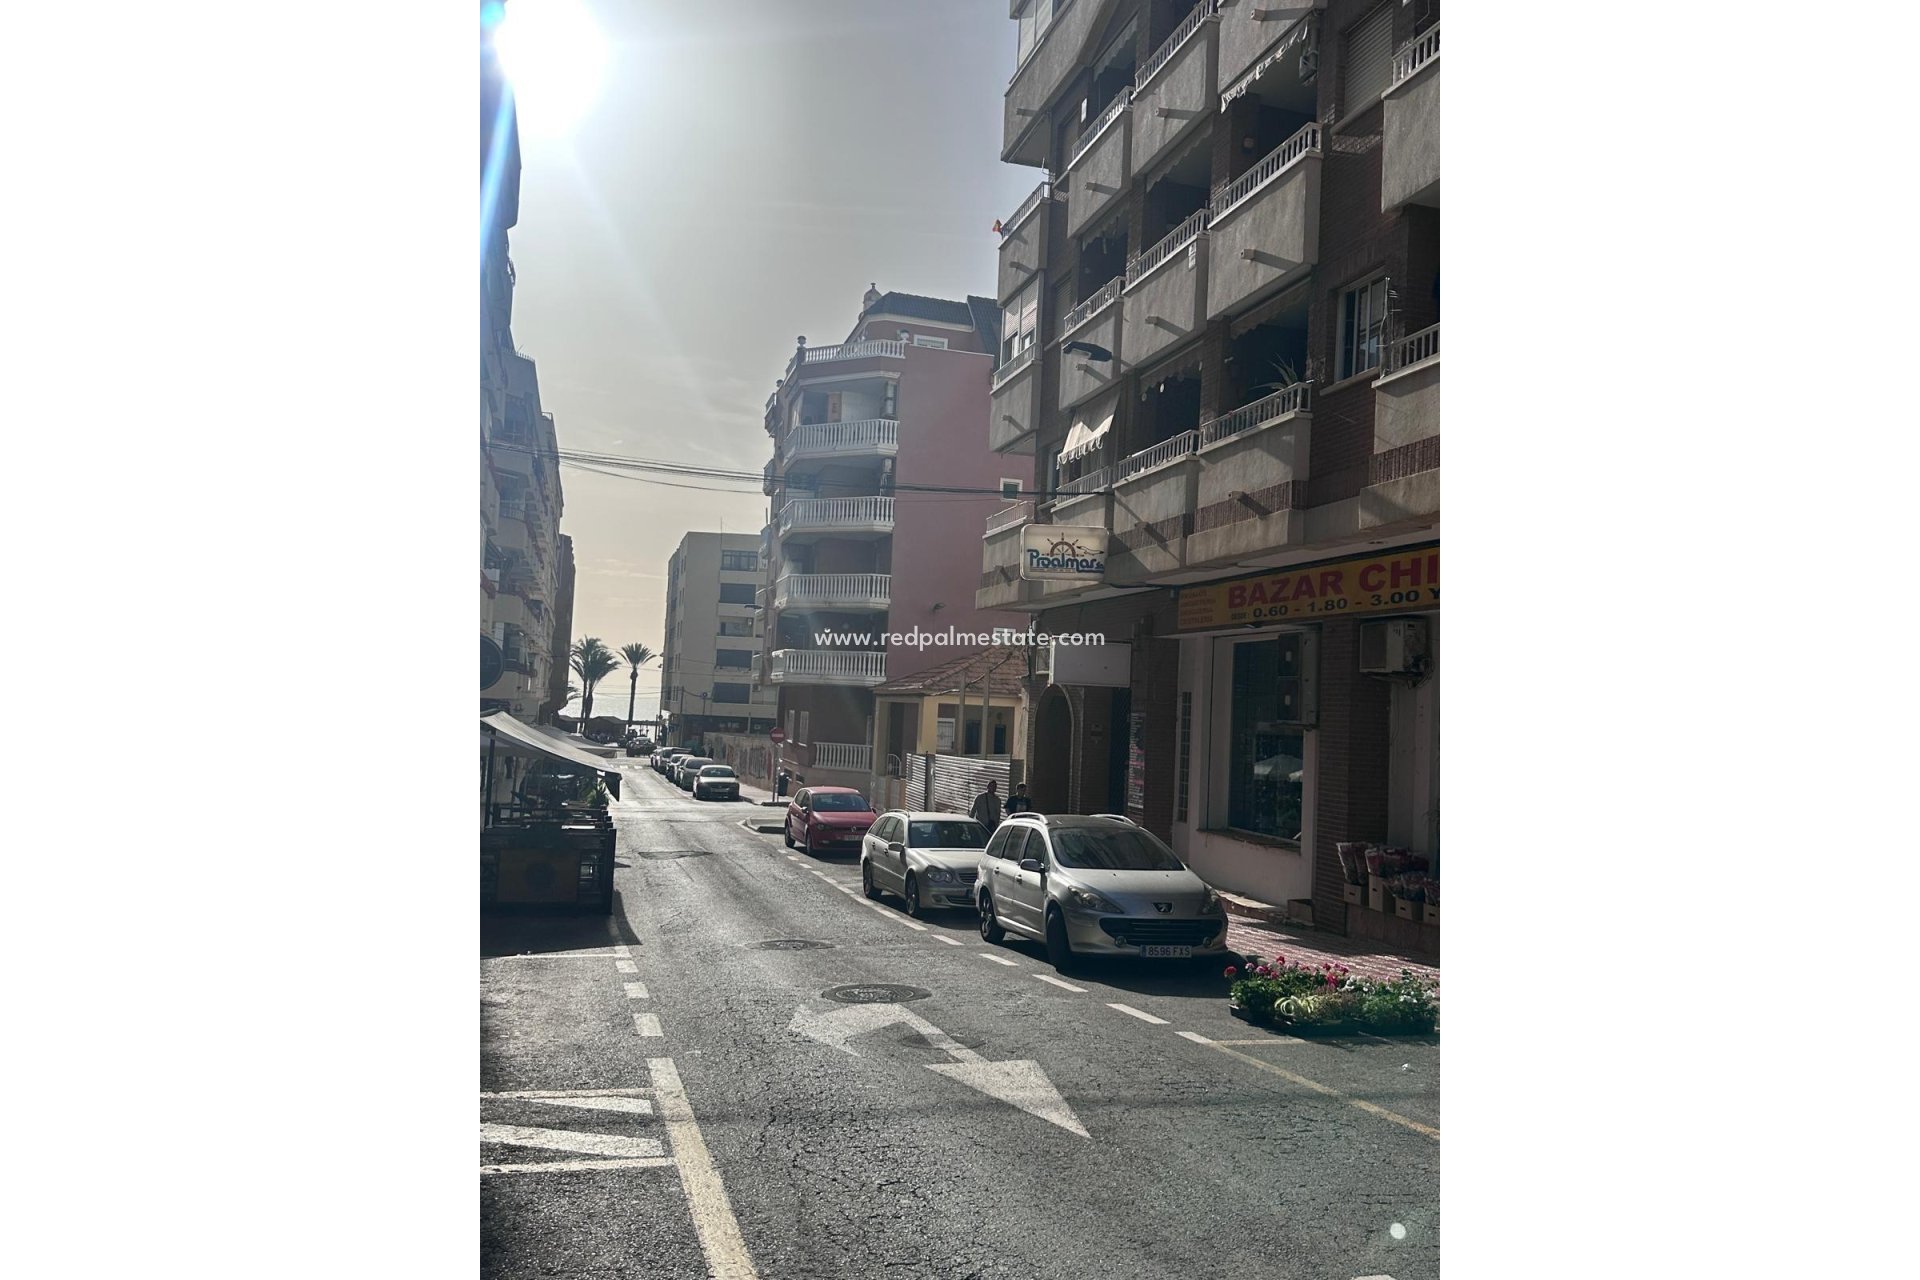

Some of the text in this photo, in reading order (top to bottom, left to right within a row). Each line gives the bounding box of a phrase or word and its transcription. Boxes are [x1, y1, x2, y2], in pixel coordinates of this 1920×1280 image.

[1228, 554, 1438, 609] BAZAR CHI
[1253, 605, 1288, 618] 0.60
[1307, 598, 1348, 613] 1.80
[1370, 590, 1420, 607] 3.00
